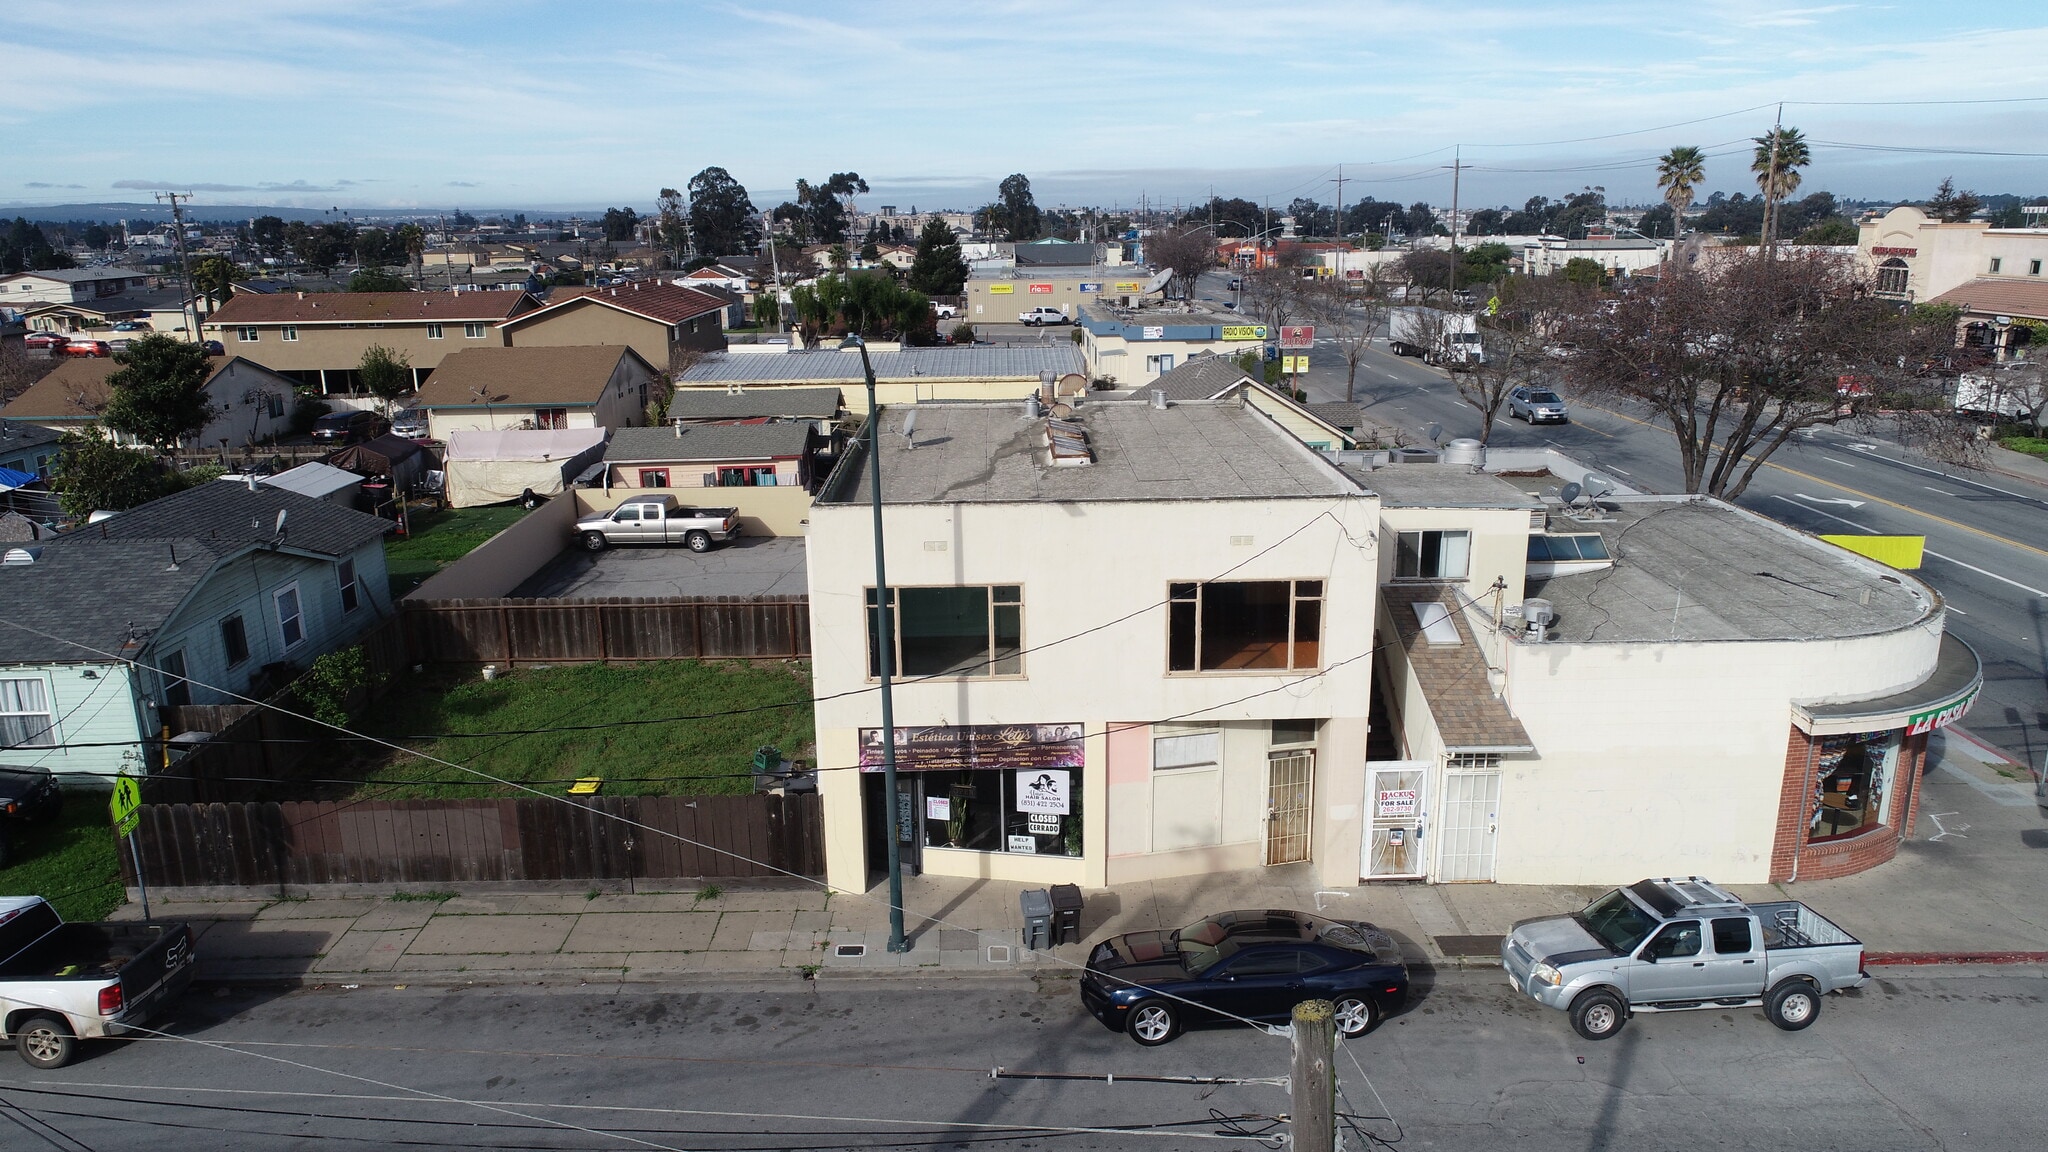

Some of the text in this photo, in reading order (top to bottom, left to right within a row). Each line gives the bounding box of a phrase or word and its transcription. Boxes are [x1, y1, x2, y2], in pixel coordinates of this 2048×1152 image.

[1223, 326, 1255, 336] RADIO VISION
[1911, 714, 1935, 735] LA
[911, 726, 1034, 746] Estética Unisex Lety's
[1381, 791, 1415, 800] BACKUS
[1030, 814, 1058, 823] CLOSED
[121, 815, 138, 835] SCHOOL
[1029, 824, 1059, 833] CERRADO
